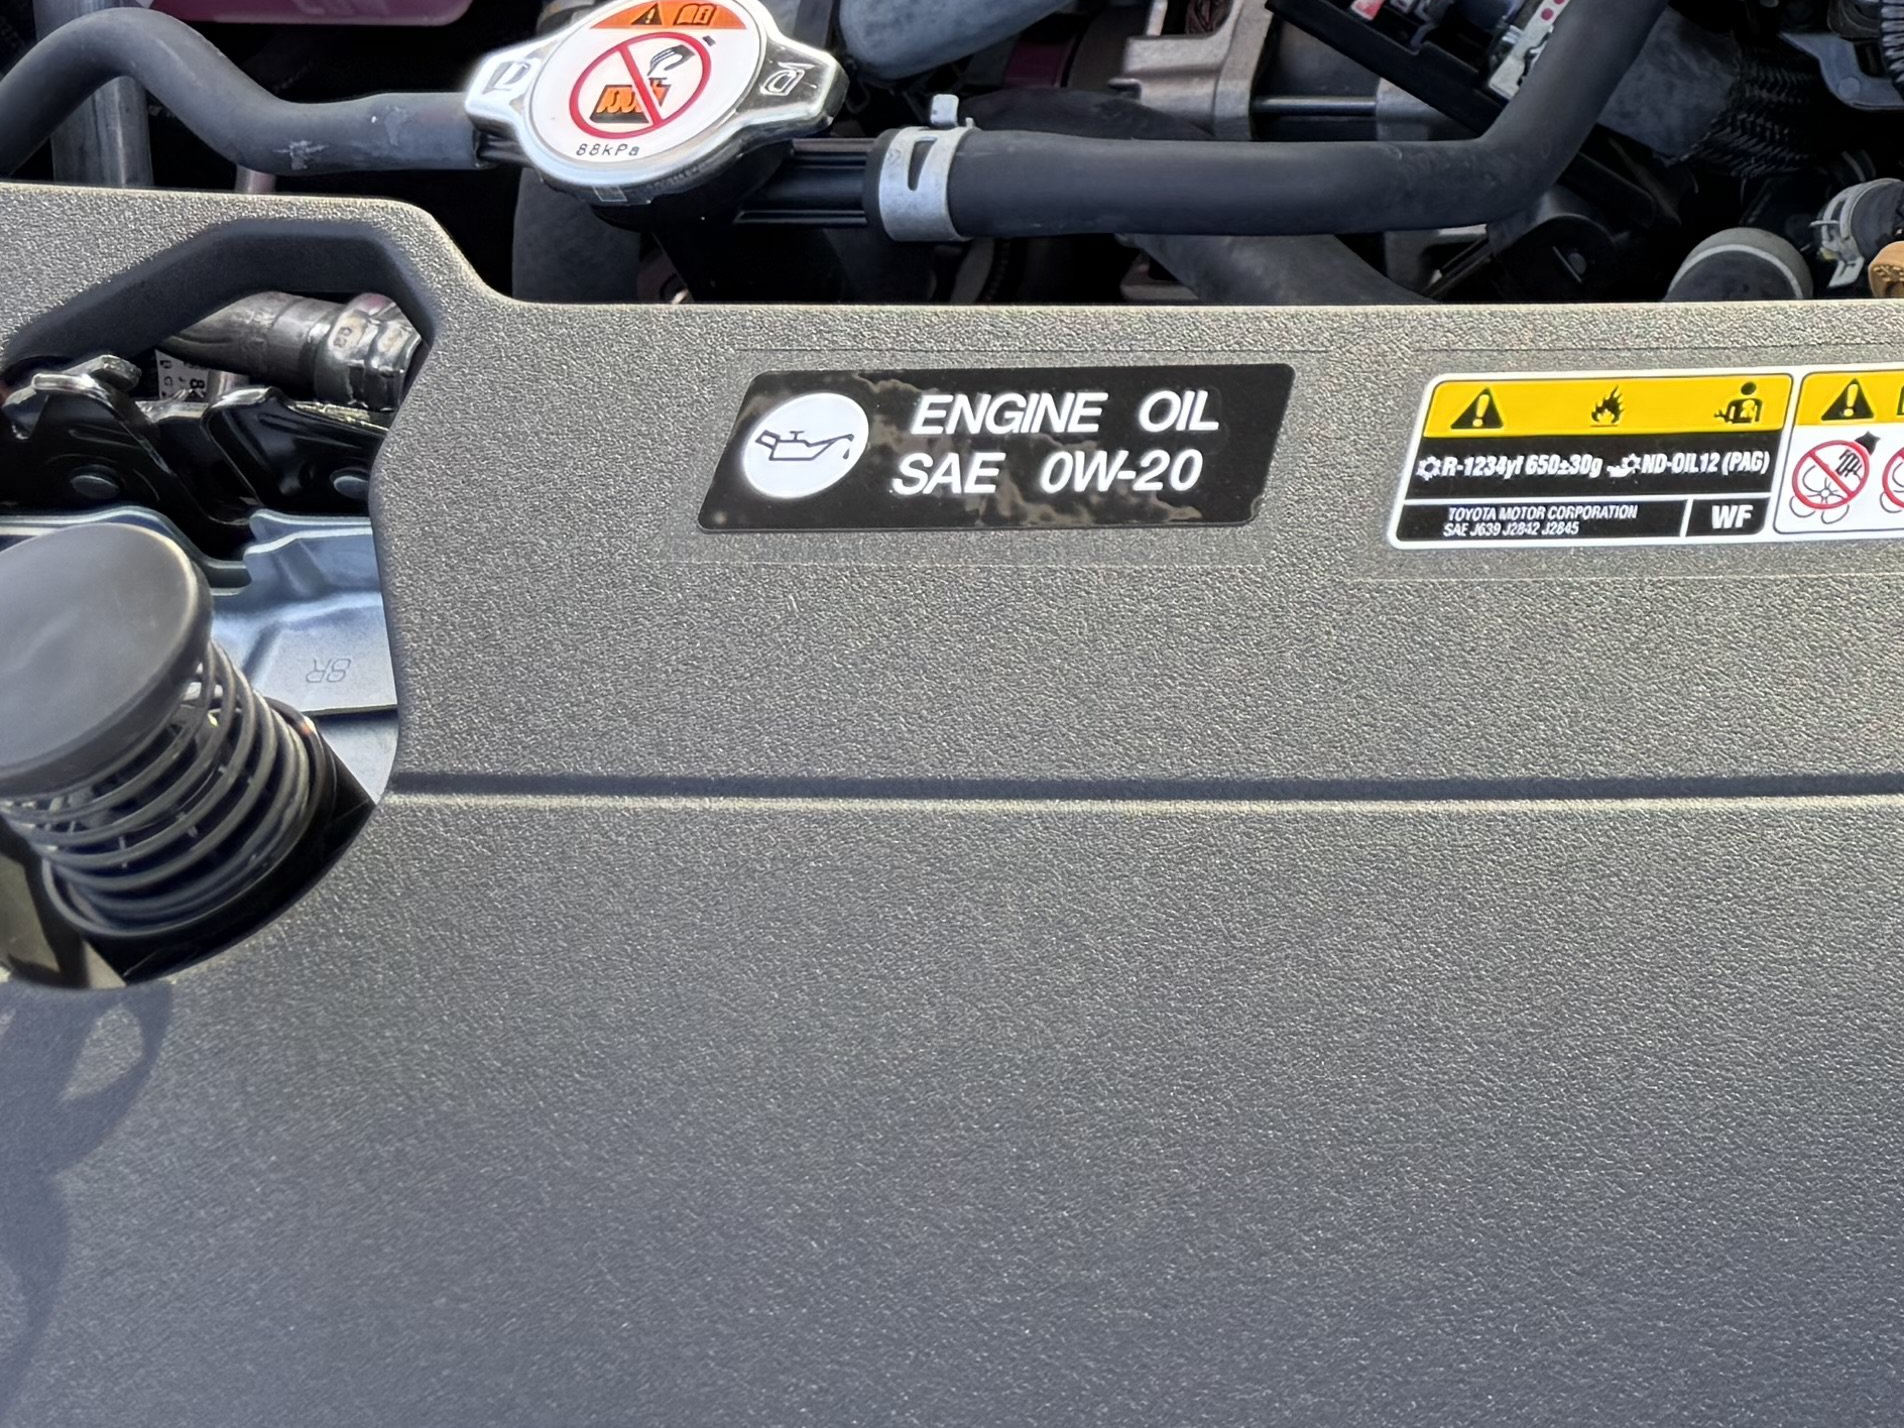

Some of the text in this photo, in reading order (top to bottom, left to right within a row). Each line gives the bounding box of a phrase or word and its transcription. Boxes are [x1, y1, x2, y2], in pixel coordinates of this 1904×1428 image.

[575, 143, 641, 157] 88kPa
[910, 390, 1220, 435] ENGINE OIL
[892, 449, 1203, 496] SAE 0W-20
[1442, 454, 1522, 479] R-1234yf
[1526, 455, 1603, 478] 650±30g
[1721, 451, 1771, 475] (PAG)
[1447, 504, 1639, 521] TOYOTA MOTOR CORPORATION
[1711, 505, 1754, 529] WF
[1443, 521, 1580, 536] SAE J639 J2842 J2845
